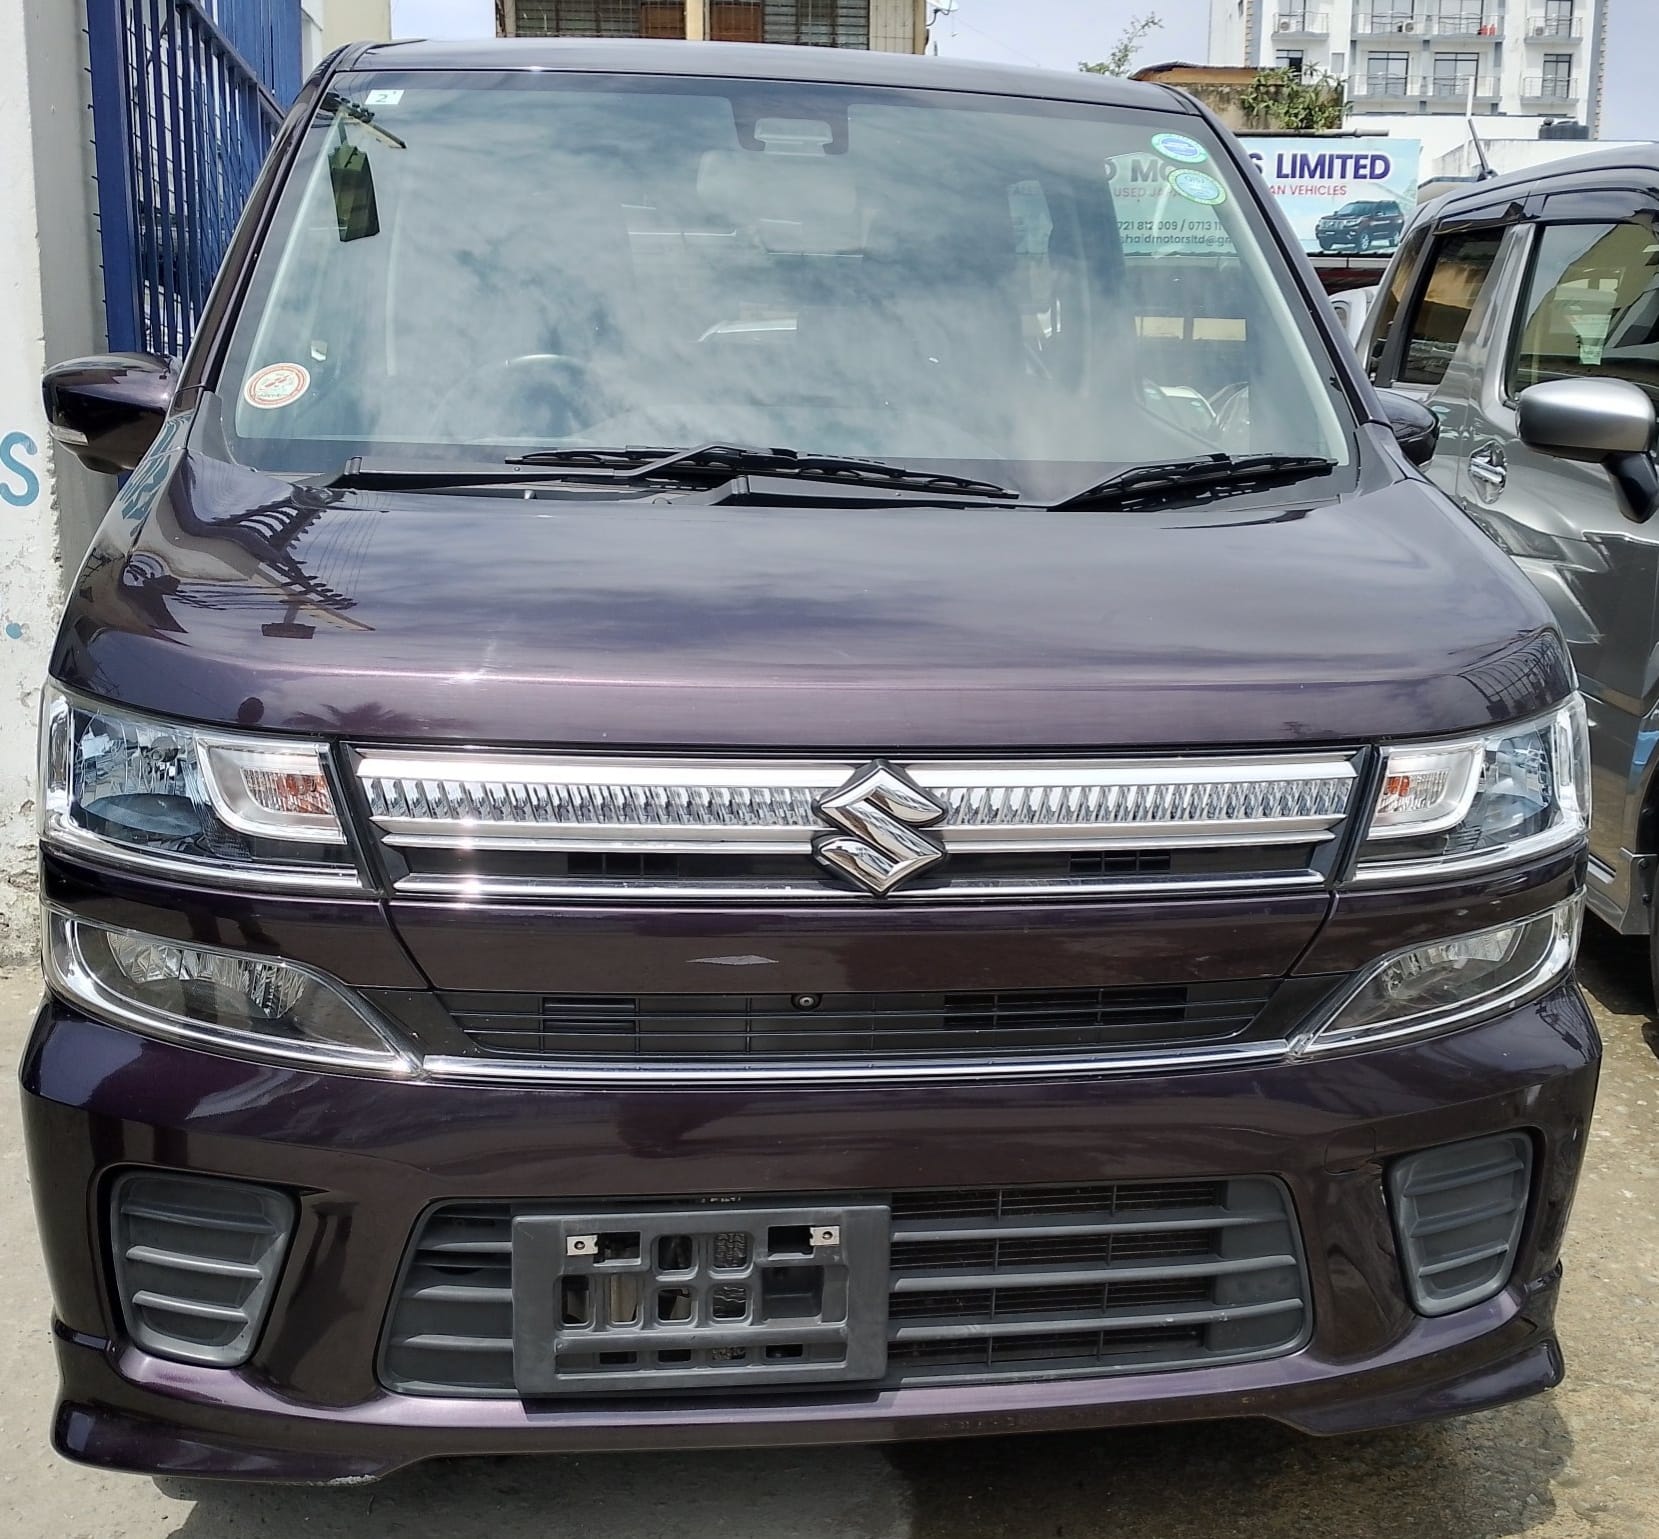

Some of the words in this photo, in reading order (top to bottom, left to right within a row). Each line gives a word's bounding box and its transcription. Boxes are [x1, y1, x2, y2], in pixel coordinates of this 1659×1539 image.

[1276, 153, 1391, 180] LIMITED
[1114, 187, 1146, 198] USED
[1289, 185, 1347, 196] VEHICLES
